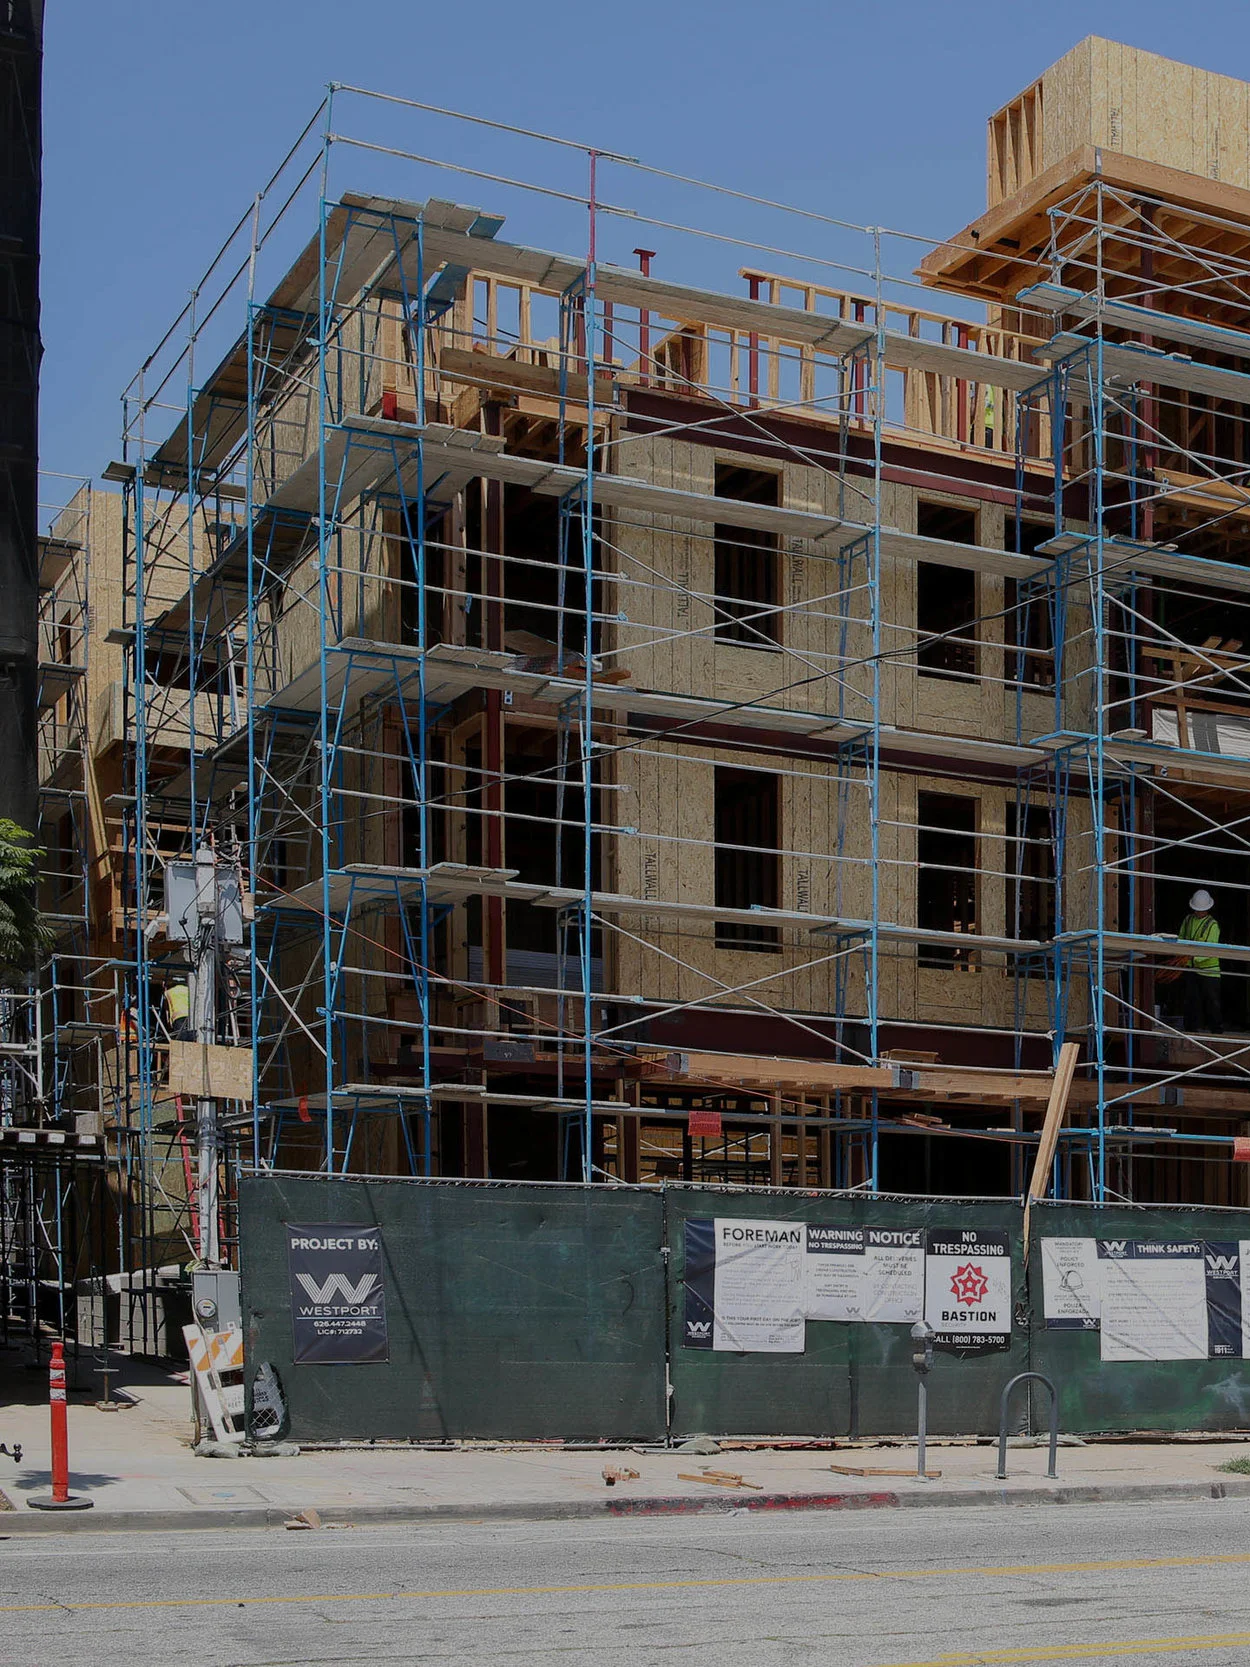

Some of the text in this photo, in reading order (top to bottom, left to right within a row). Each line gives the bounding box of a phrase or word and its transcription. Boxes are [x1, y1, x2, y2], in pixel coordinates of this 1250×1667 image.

[644, 852, 657, 900] TALLWALL
[723, 1227, 801, 1243] FOREMAN
[809, 1229, 864, 1241] WARNING
[869, 1231, 920, 1245] NOTICE
[962, 1231, 977, 1242] NO
[291, 1238, 378, 1251] PROJECT BY:
[820, 1242, 864, 1251] TRESPASSING
[933, 1244, 1004, 1256] TRESPASSING
[1137, 1244, 1201, 1253] THINK SAFETY:
[299, 1306, 378, 1316] WESTPORT
[941, 1311, 996, 1322] BASTION
[952, 1335, 971, 1344] (800)
[972, 1335, 1005, 1344] 783-5700
